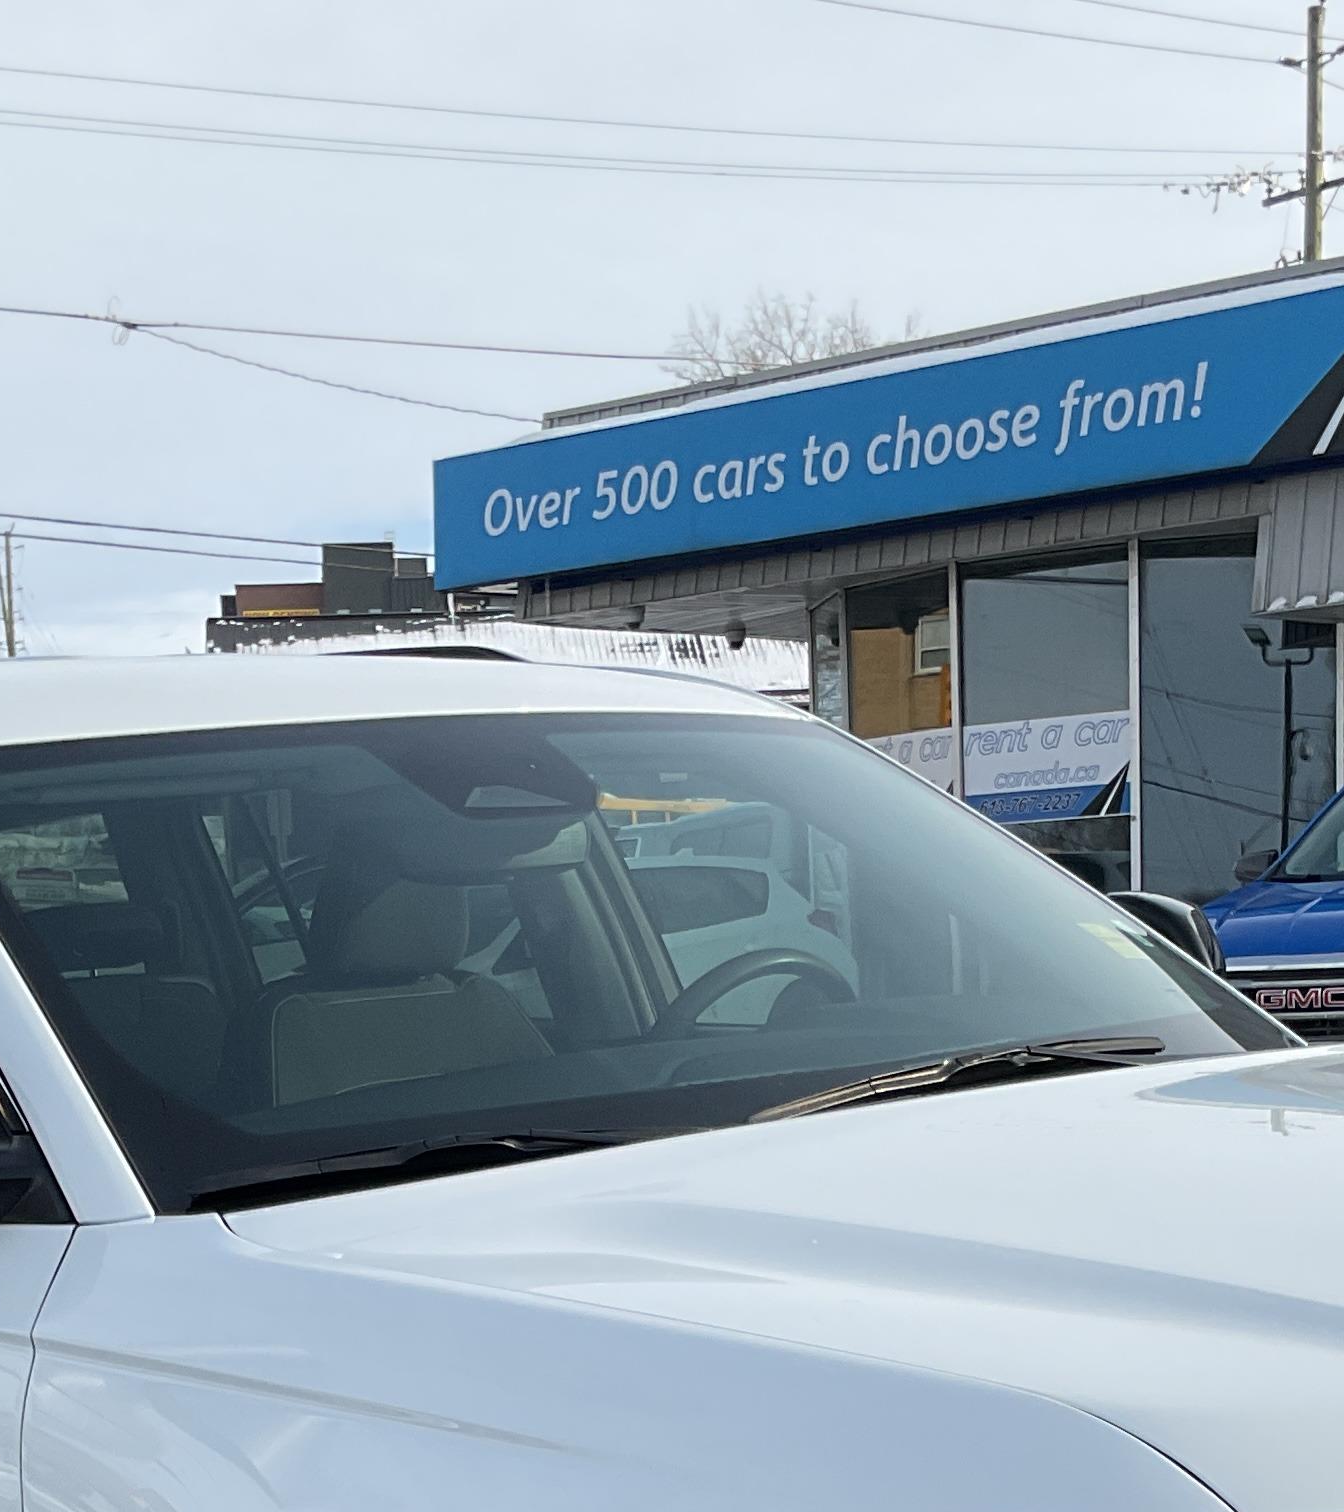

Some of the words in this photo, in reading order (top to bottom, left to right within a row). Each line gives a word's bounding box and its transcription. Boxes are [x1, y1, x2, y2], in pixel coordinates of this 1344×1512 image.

[484, 485, 580, 537] Over
[591, 459, 677, 522] 500
[692, 449, 787, 504] cars
[802, 434, 849, 488] to
[866, 403, 1040, 476] choose
[1056, 361, 1209, 456] from!
[965, 721, 1032, 757] rent
[1041, 724, 1063, 750] a
[1074, 717, 1130, 747] car
[994, 760, 1100, 789] canada.ca
